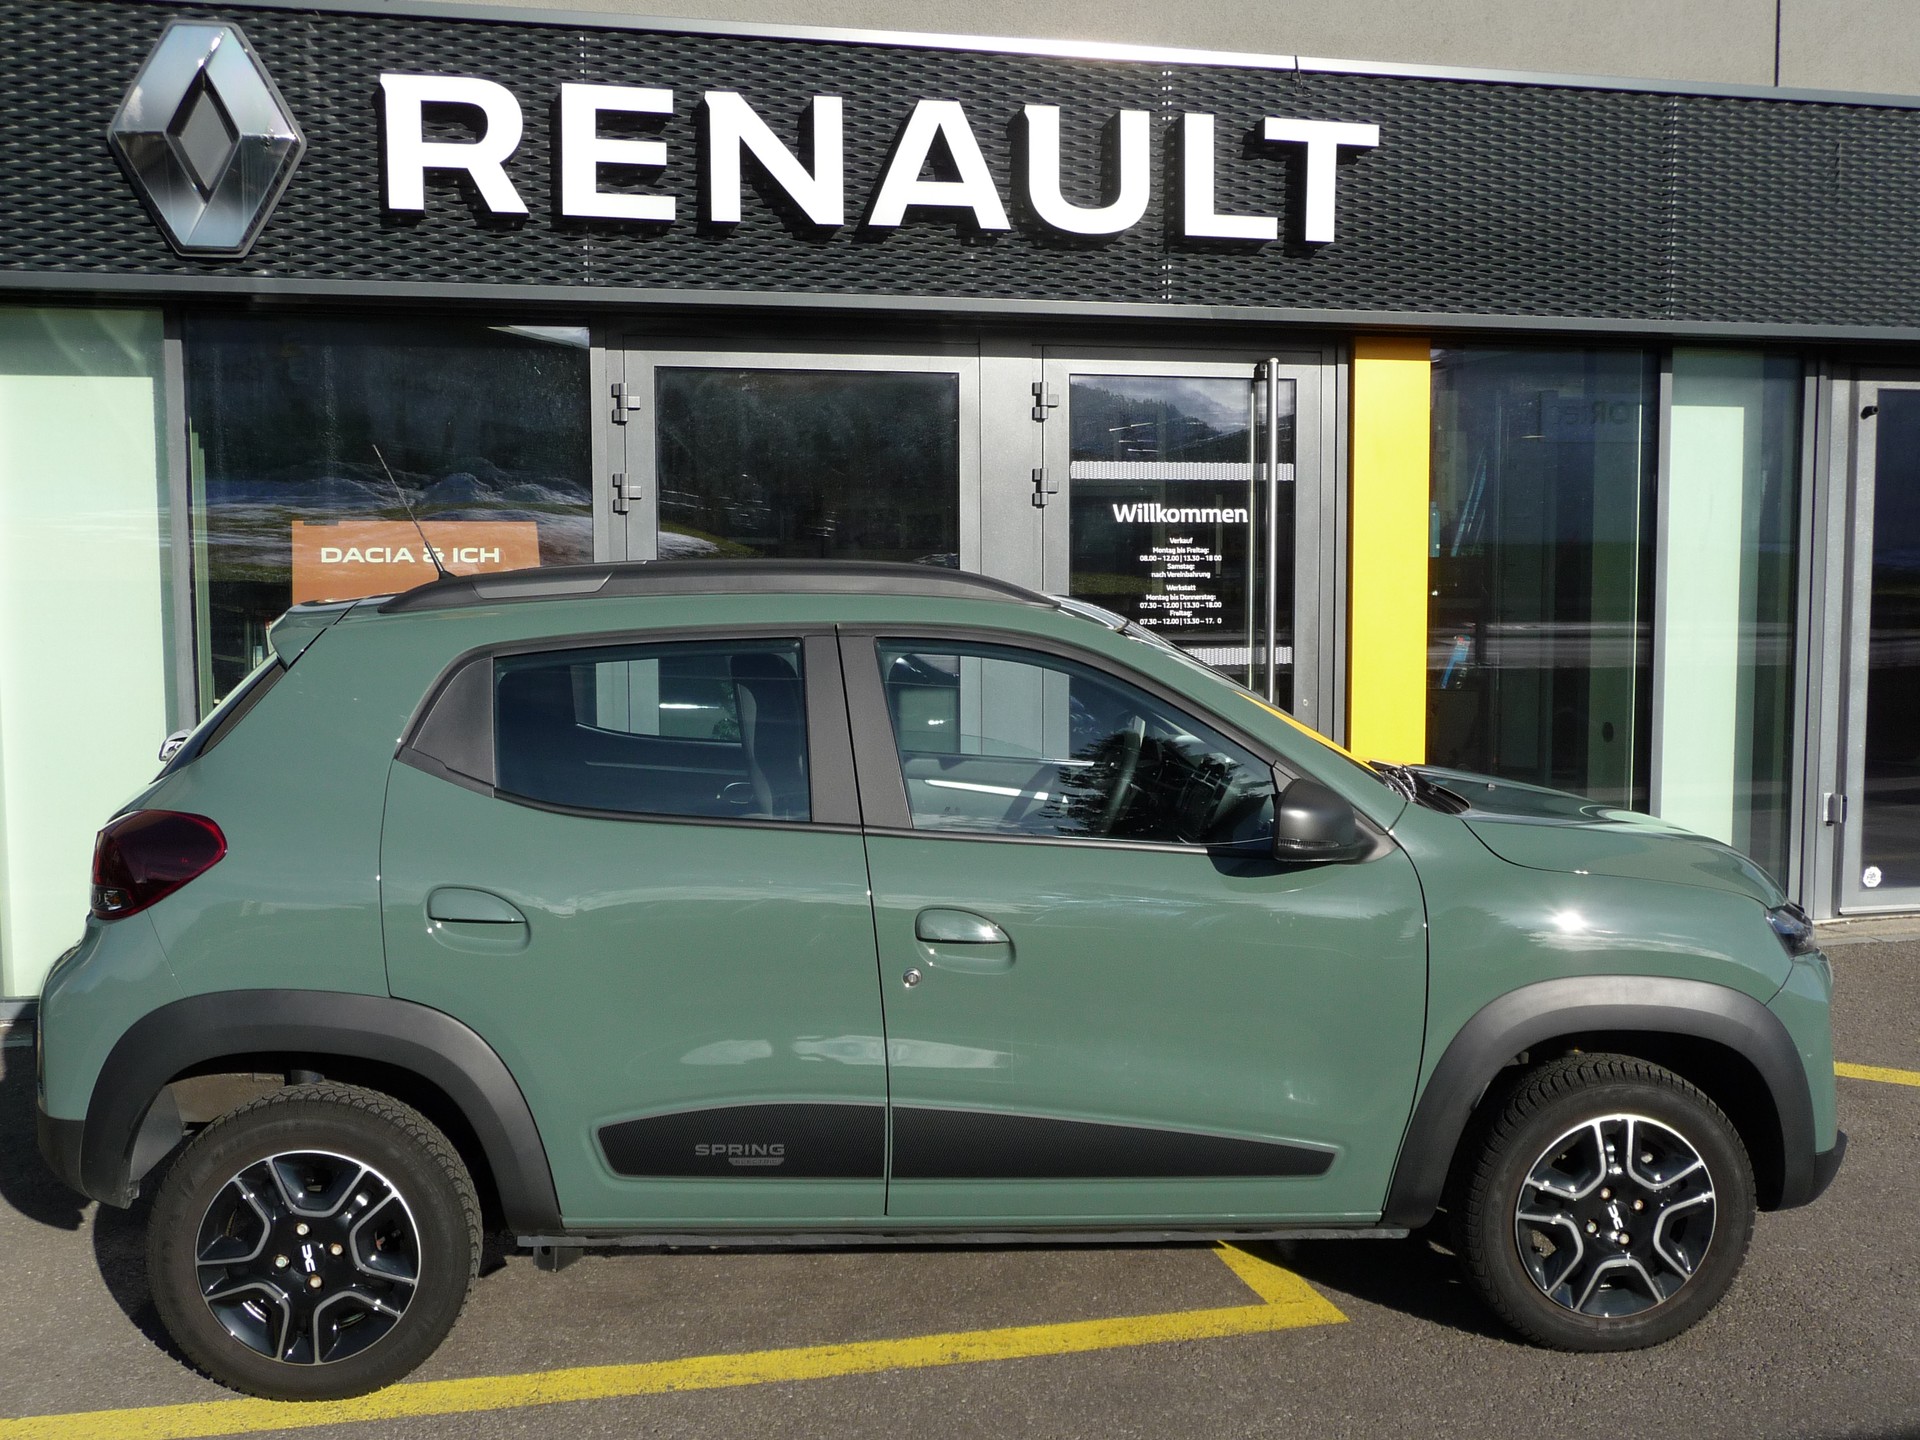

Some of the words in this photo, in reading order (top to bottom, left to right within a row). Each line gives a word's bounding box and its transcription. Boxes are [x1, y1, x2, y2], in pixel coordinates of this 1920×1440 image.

[379, 73, 1380, 242] RENAULT
[1112, 503, 1248, 523] Willkommen
[321, 547, 415, 563] DACIA
[453, 547, 500, 563] ICH
[1166, 563, 1195, 571] Samstag:
[1145, 594, 1170, 602] Montag
[694, 1144, 785, 1156] SPRING
